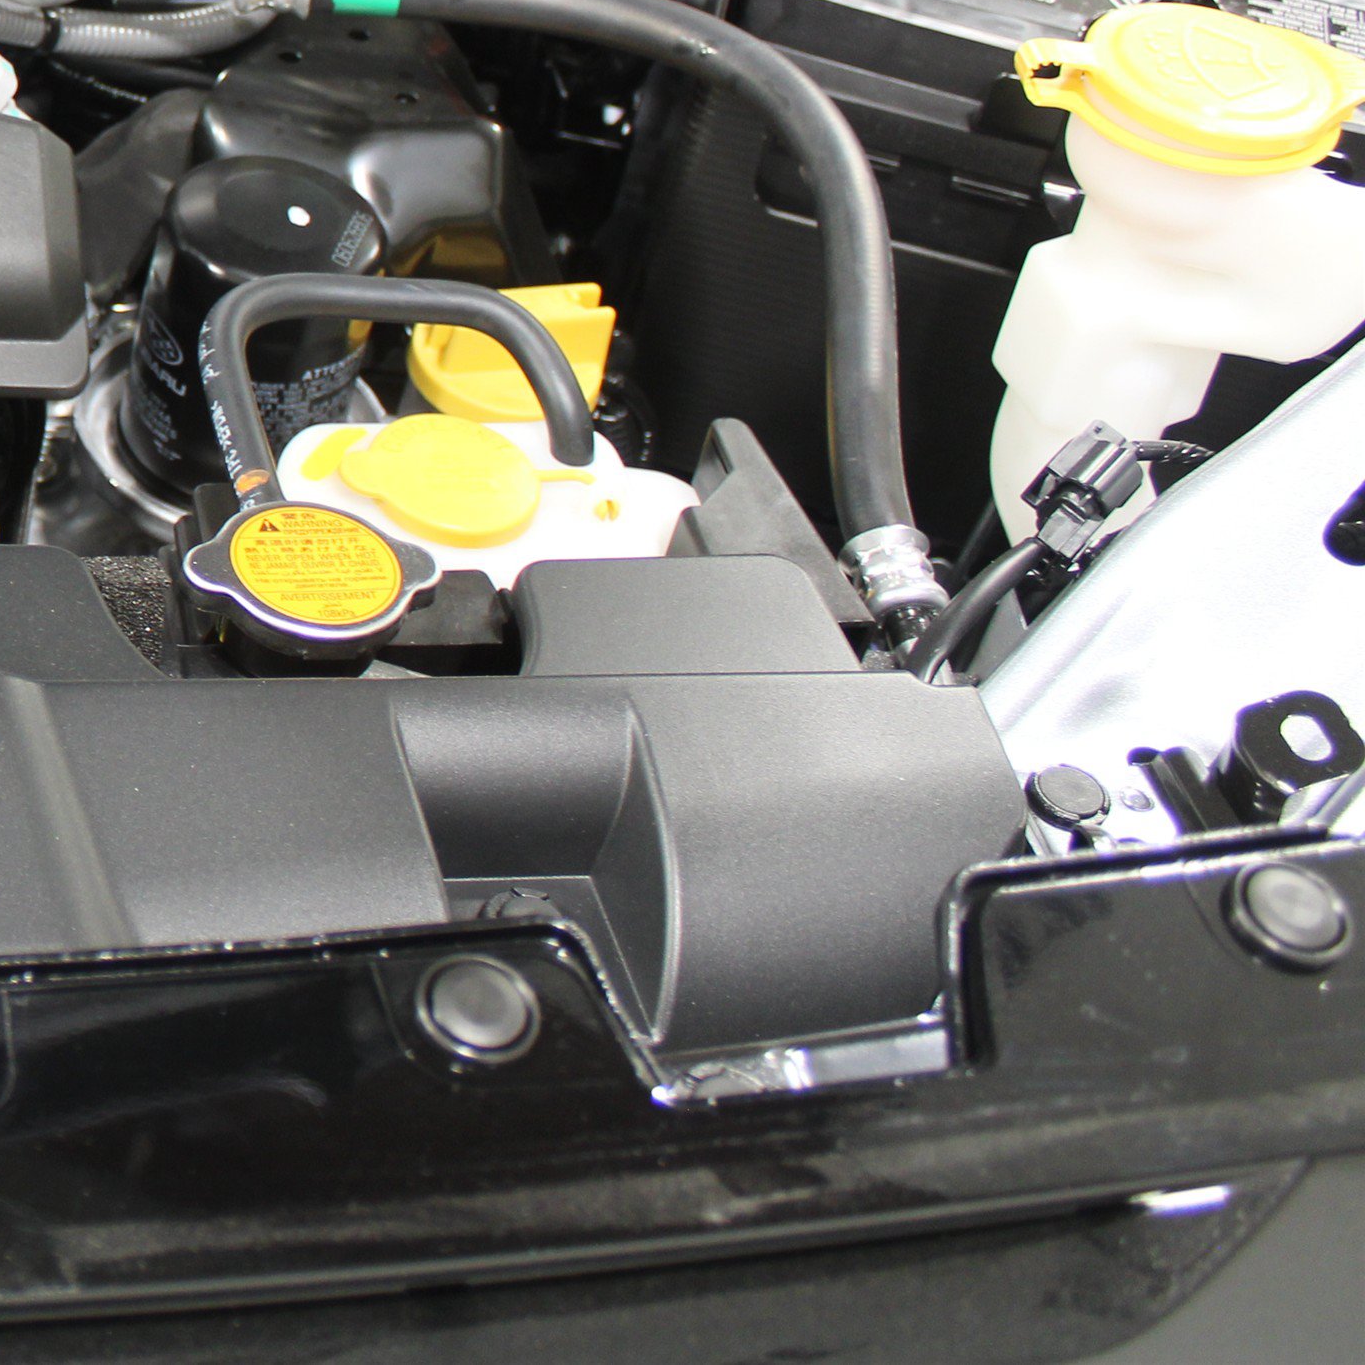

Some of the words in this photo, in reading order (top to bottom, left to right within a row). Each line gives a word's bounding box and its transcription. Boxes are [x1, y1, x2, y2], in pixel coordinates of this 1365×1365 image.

[281, 519, 343, 529] WARNING
[245, 554, 282, 563] NEVER
[286, 553, 315, 562] OPEN
[320, 552, 352, 561] WHEN
[248, 561, 262, 569] NE
[267, 560, 298, 569] JAMAIS
[280, 591, 377, 602] AVERTISSEMENT
